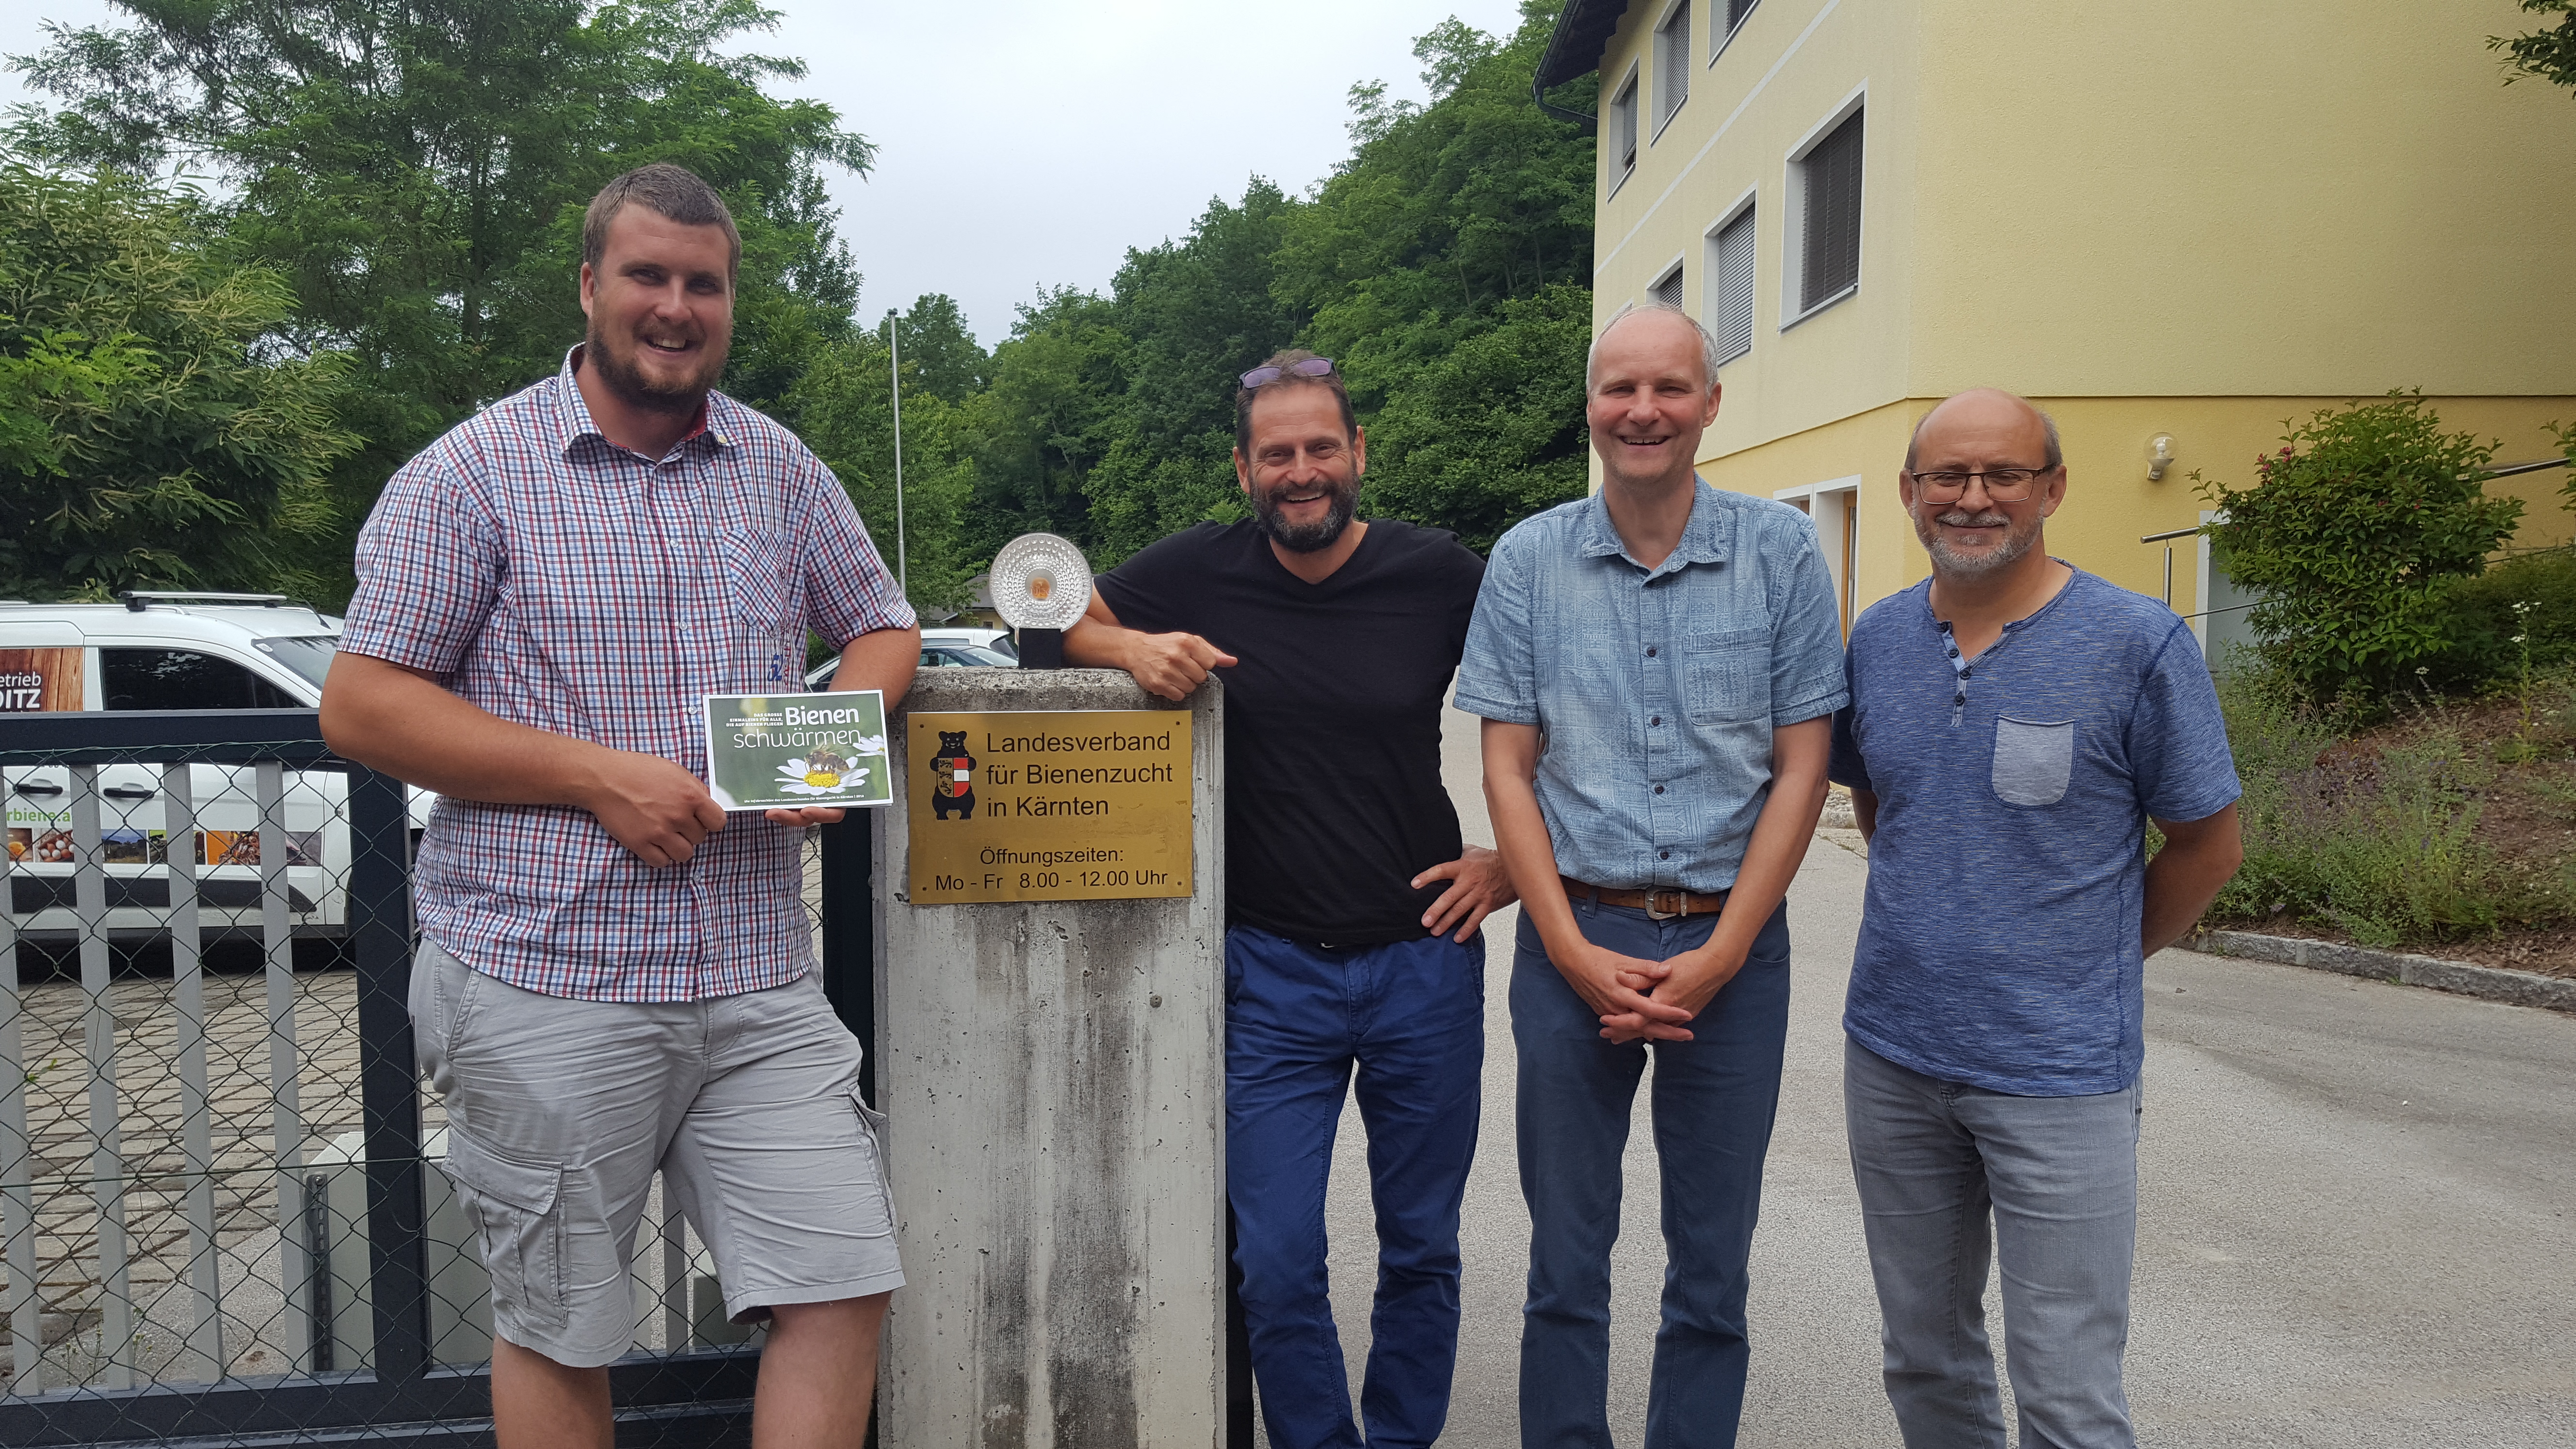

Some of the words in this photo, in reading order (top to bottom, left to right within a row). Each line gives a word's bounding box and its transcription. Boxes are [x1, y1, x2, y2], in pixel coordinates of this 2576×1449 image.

[0, 689, 41, 709] ITZ
[785, 706, 859, 725] Bienen
[733, 728, 861, 748] schwärmen
[987, 730, 1170, 753] Landesverband
[986, 764, 1019, 785] für
[1027, 762, 1173, 784] Bienenzucht
[988, 798, 1007, 817] in
[1017, 796, 1108, 817] Kärnten
[980, 846, 1124, 867] Öffnungszeiten:
[936, 875, 964, 891] Mo
[984, 873, 1003, 889] Fr
[1019, 872, 1059, 888] 8.00
[1079, 870, 1129, 887] 12.00
[1136, 869, 1168, 886] Uhr
